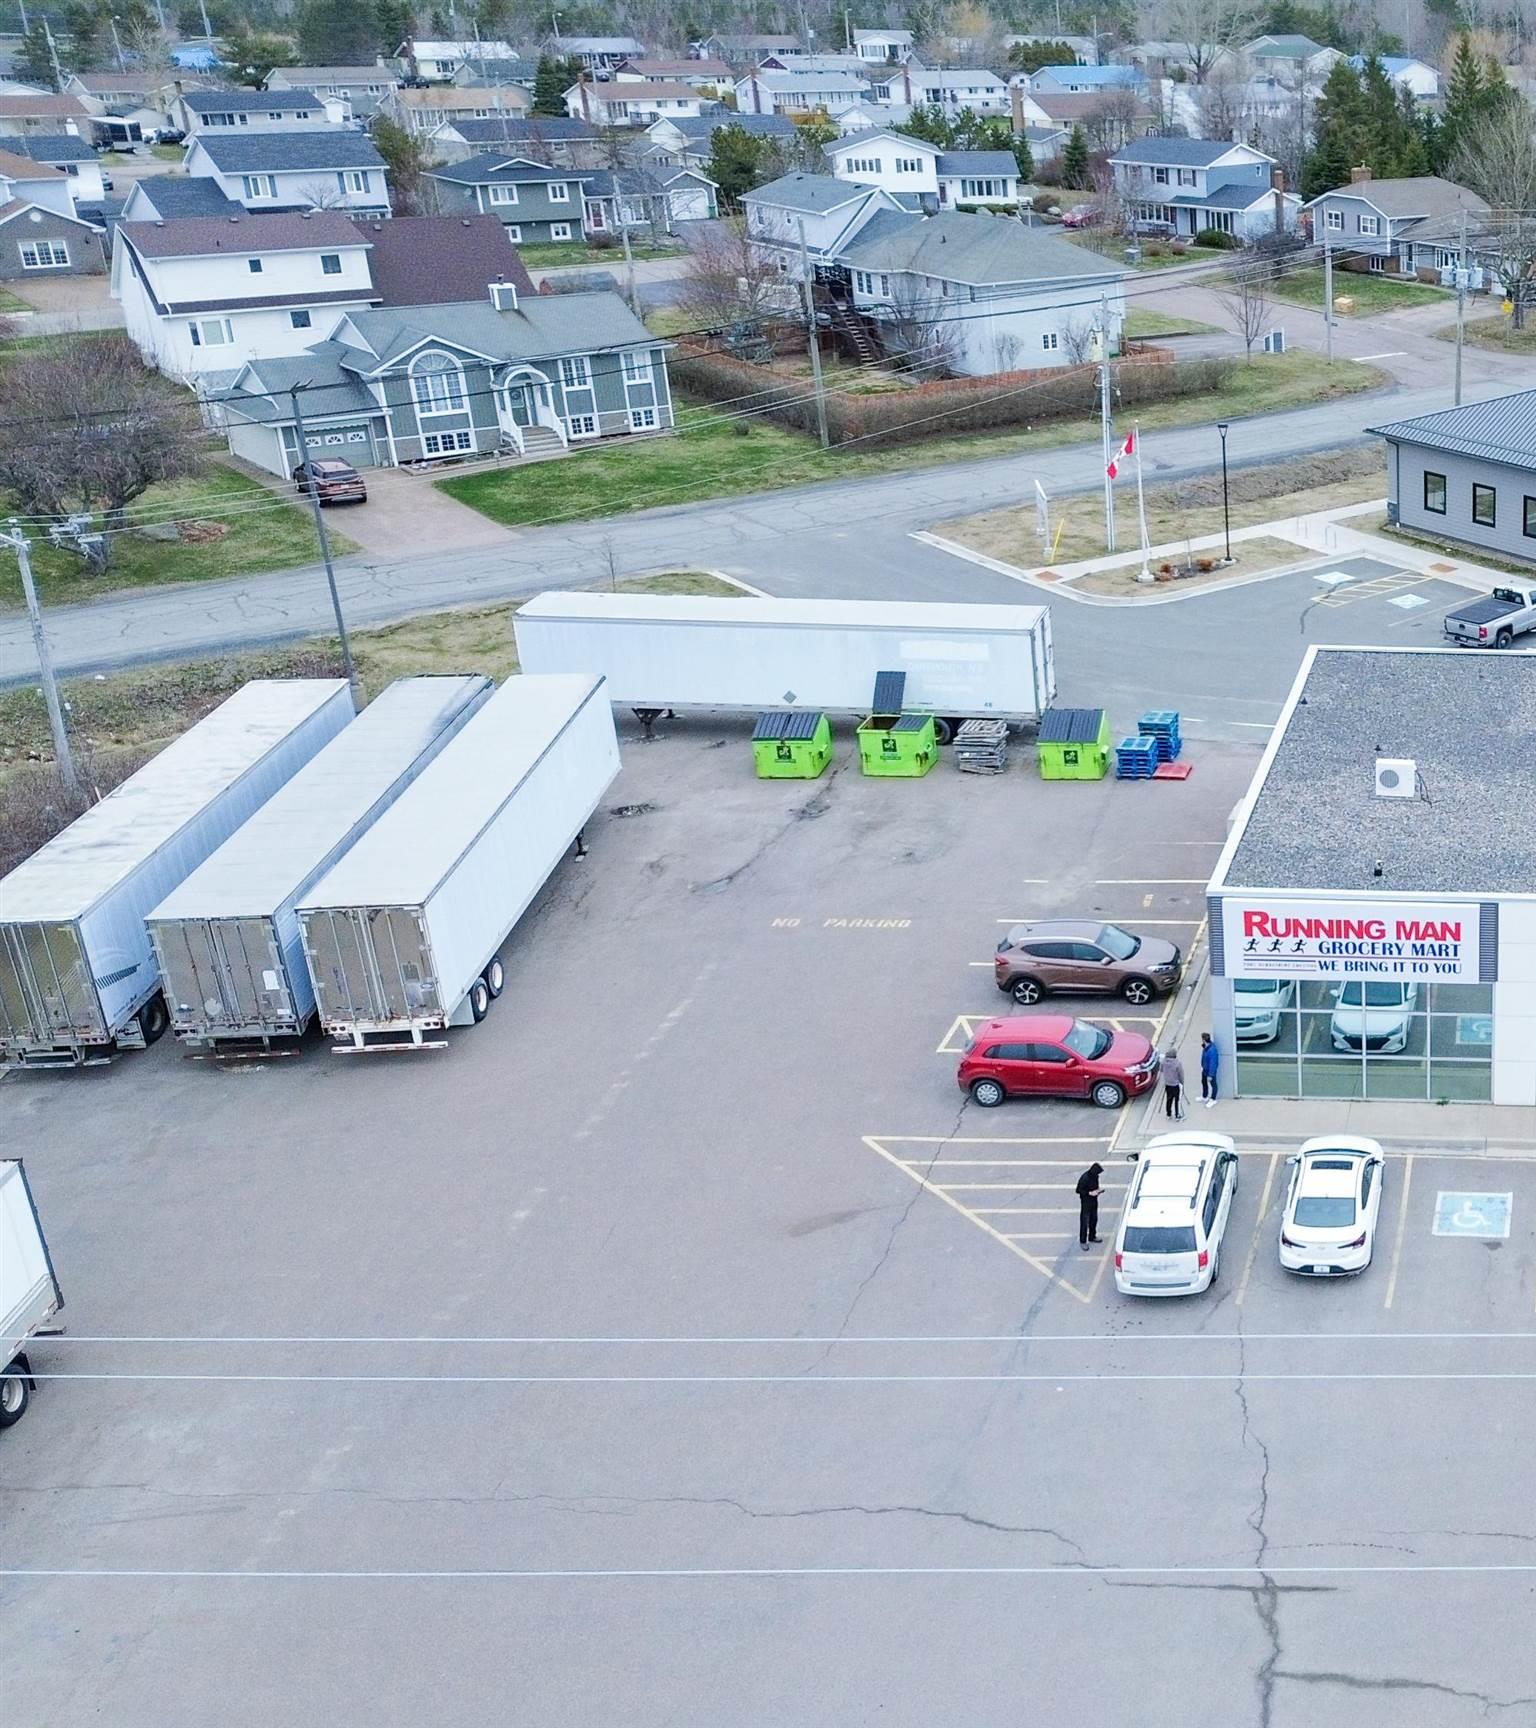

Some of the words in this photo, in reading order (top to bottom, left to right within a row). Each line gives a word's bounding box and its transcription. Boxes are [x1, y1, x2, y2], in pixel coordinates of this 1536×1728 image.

[770, 918, 801, 928] NO
[823, 918, 913, 928] PARKING
[1243, 910, 1387, 941] RUNNING
[1396, 921, 1462, 942] MAN
[1318, 940, 1405, 956] GROCERY
[1411, 943, 1461, 958] MART
[1318, 959, 1340, 972] WE
[1344, 960, 1388, 973] BRING
[1393, 961, 1405, 973] IT
[1409, 962, 1429, 974] TO
[1433, 962, 1462, 975] YOU
